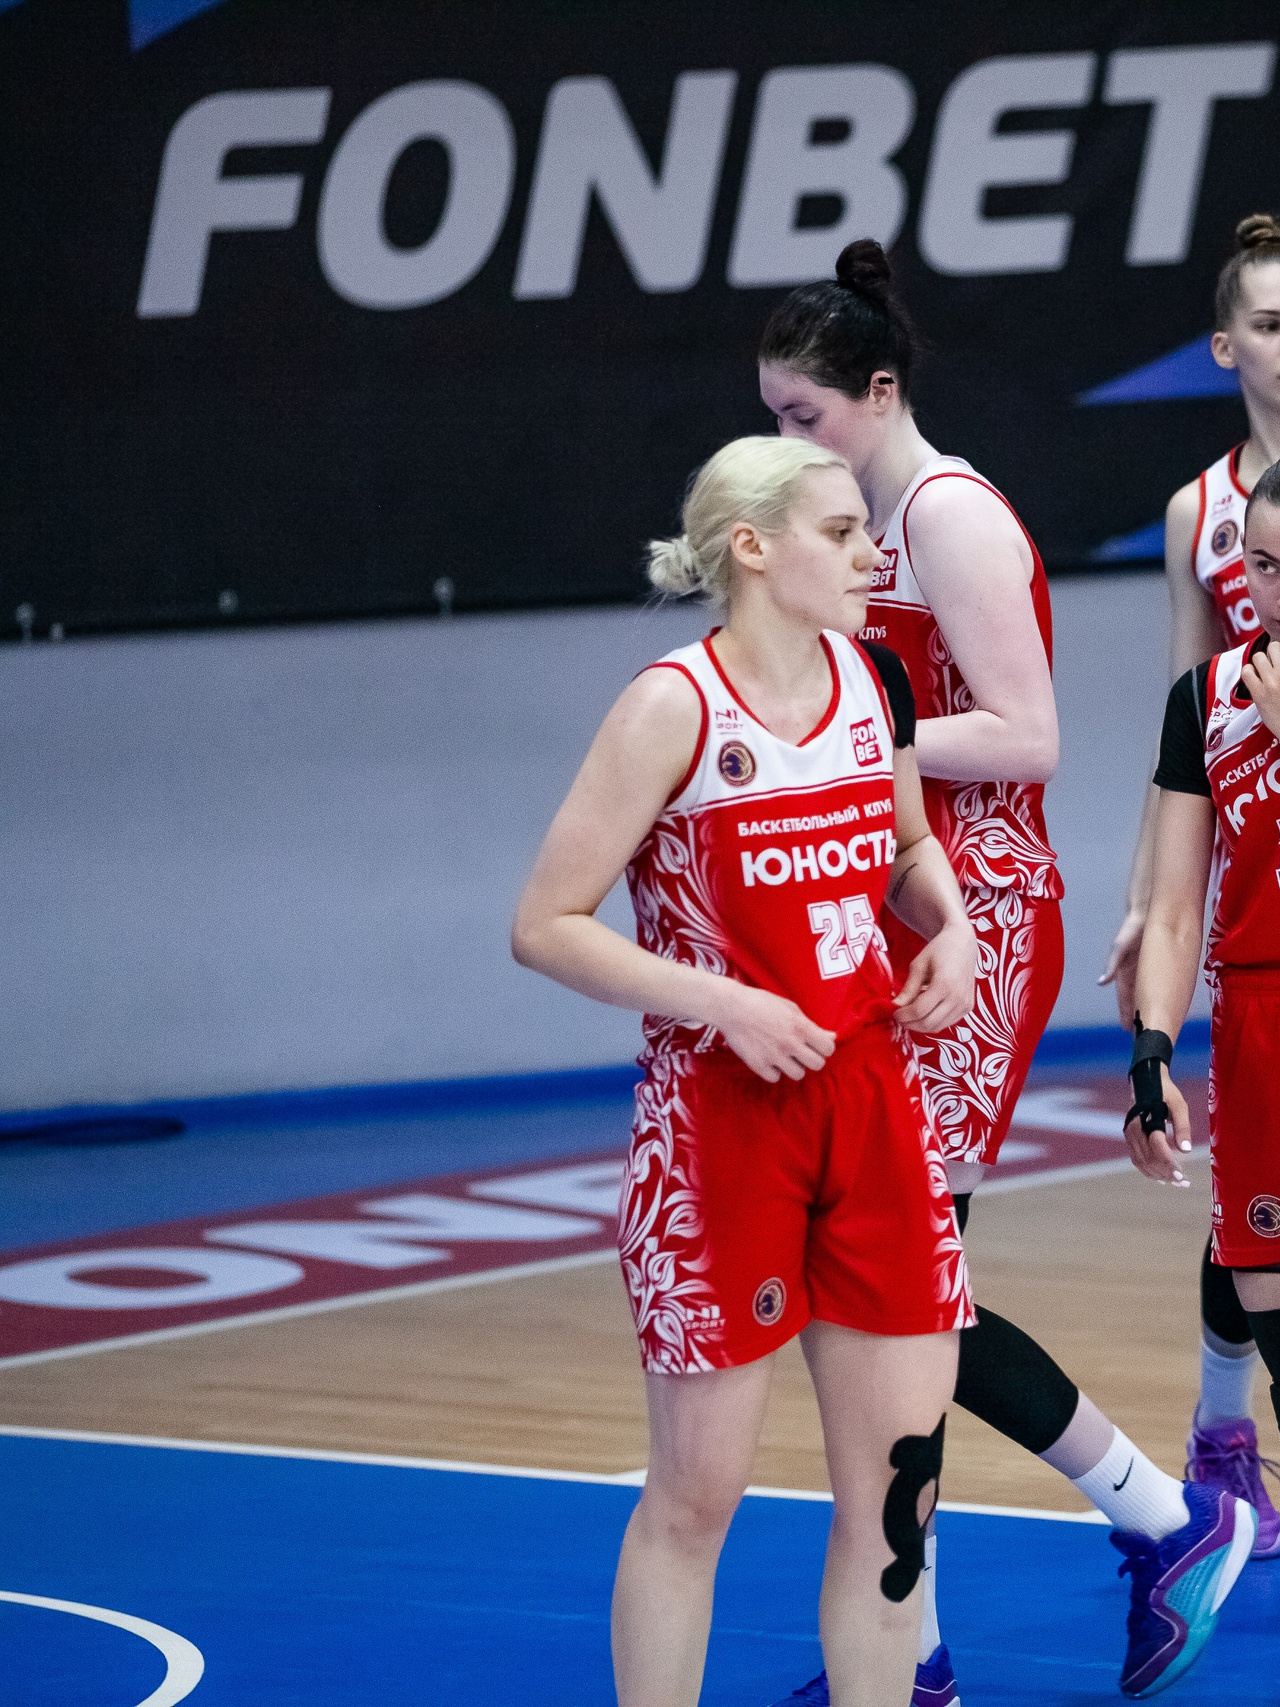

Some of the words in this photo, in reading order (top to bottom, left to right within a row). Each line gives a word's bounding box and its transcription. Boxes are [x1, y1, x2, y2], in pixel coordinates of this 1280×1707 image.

[136, 42, 1277, 319] FONBET
[859, 625, 887, 640] КЛУБ
[737, 804, 860, 837] БАСКЕТБОЛЬНЫЙ
[740, 829, 897, 887] ЮНОСТЬ
[807, 893, 888, 981] 25
